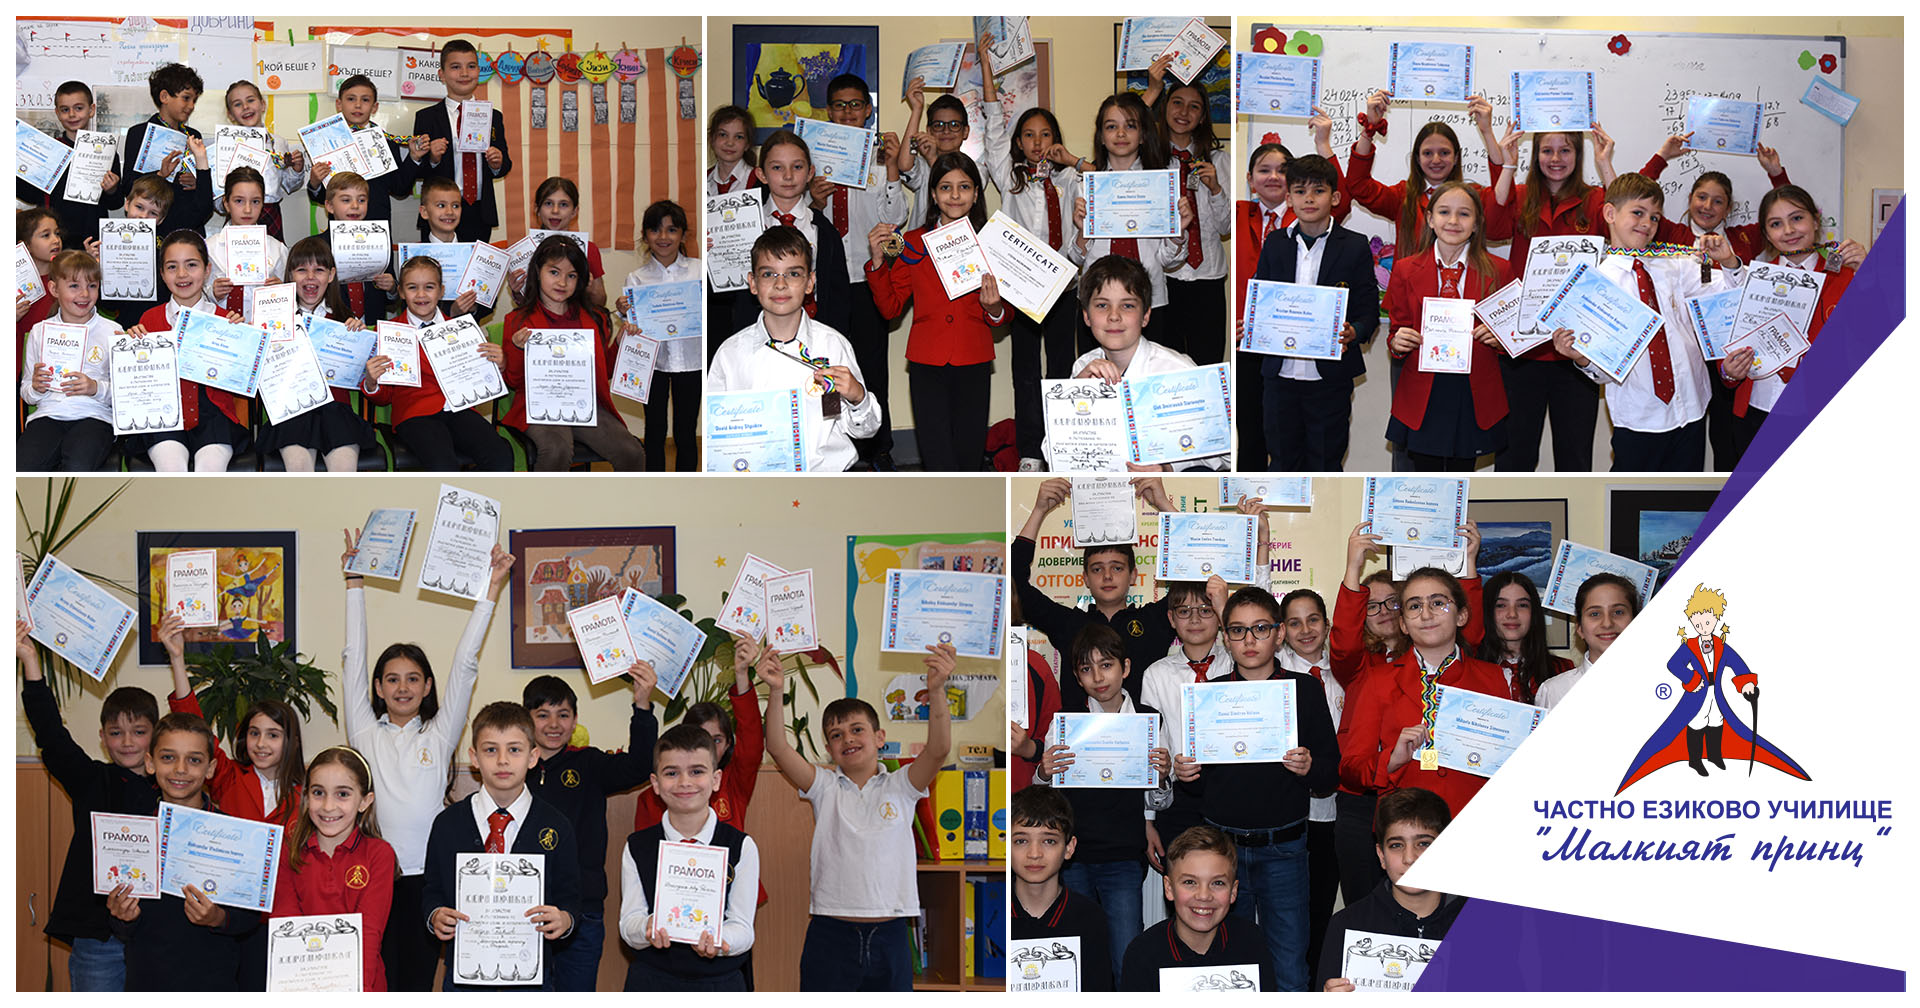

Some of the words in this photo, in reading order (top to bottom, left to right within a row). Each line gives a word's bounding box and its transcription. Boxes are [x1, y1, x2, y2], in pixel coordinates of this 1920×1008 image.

[265, 63, 283, 72] КОЙ
[285, 62, 308, 71] БЕШЕ
[419, 59, 441, 68] КАКВ
[586, 60, 609, 73] Зизи
[231, 239, 261, 247] ГРАМОТА
[935, 234, 970, 254] ГРАМОТА
[1002, 229, 1060, 274] CERTIFICATE
[475, 254, 502, 271] ГРАМОТА
[47, 338, 80, 348] ГРАМОТА
[384, 336, 413, 346] ГРАМОТА
[1767, 325, 1793, 354] ГРАМОТА
[624, 344, 651, 360] ГРАМОТА
[173, 567, 209, 578] ГРАМОТА
[770, 589, 805, 603] ГРАМОТА
[580, 615, 617, 634] ГРАМОТА
[102, 831, 150, 844] ГРАМОТА
[667, 864, 716, 880] ГРАМОТА
